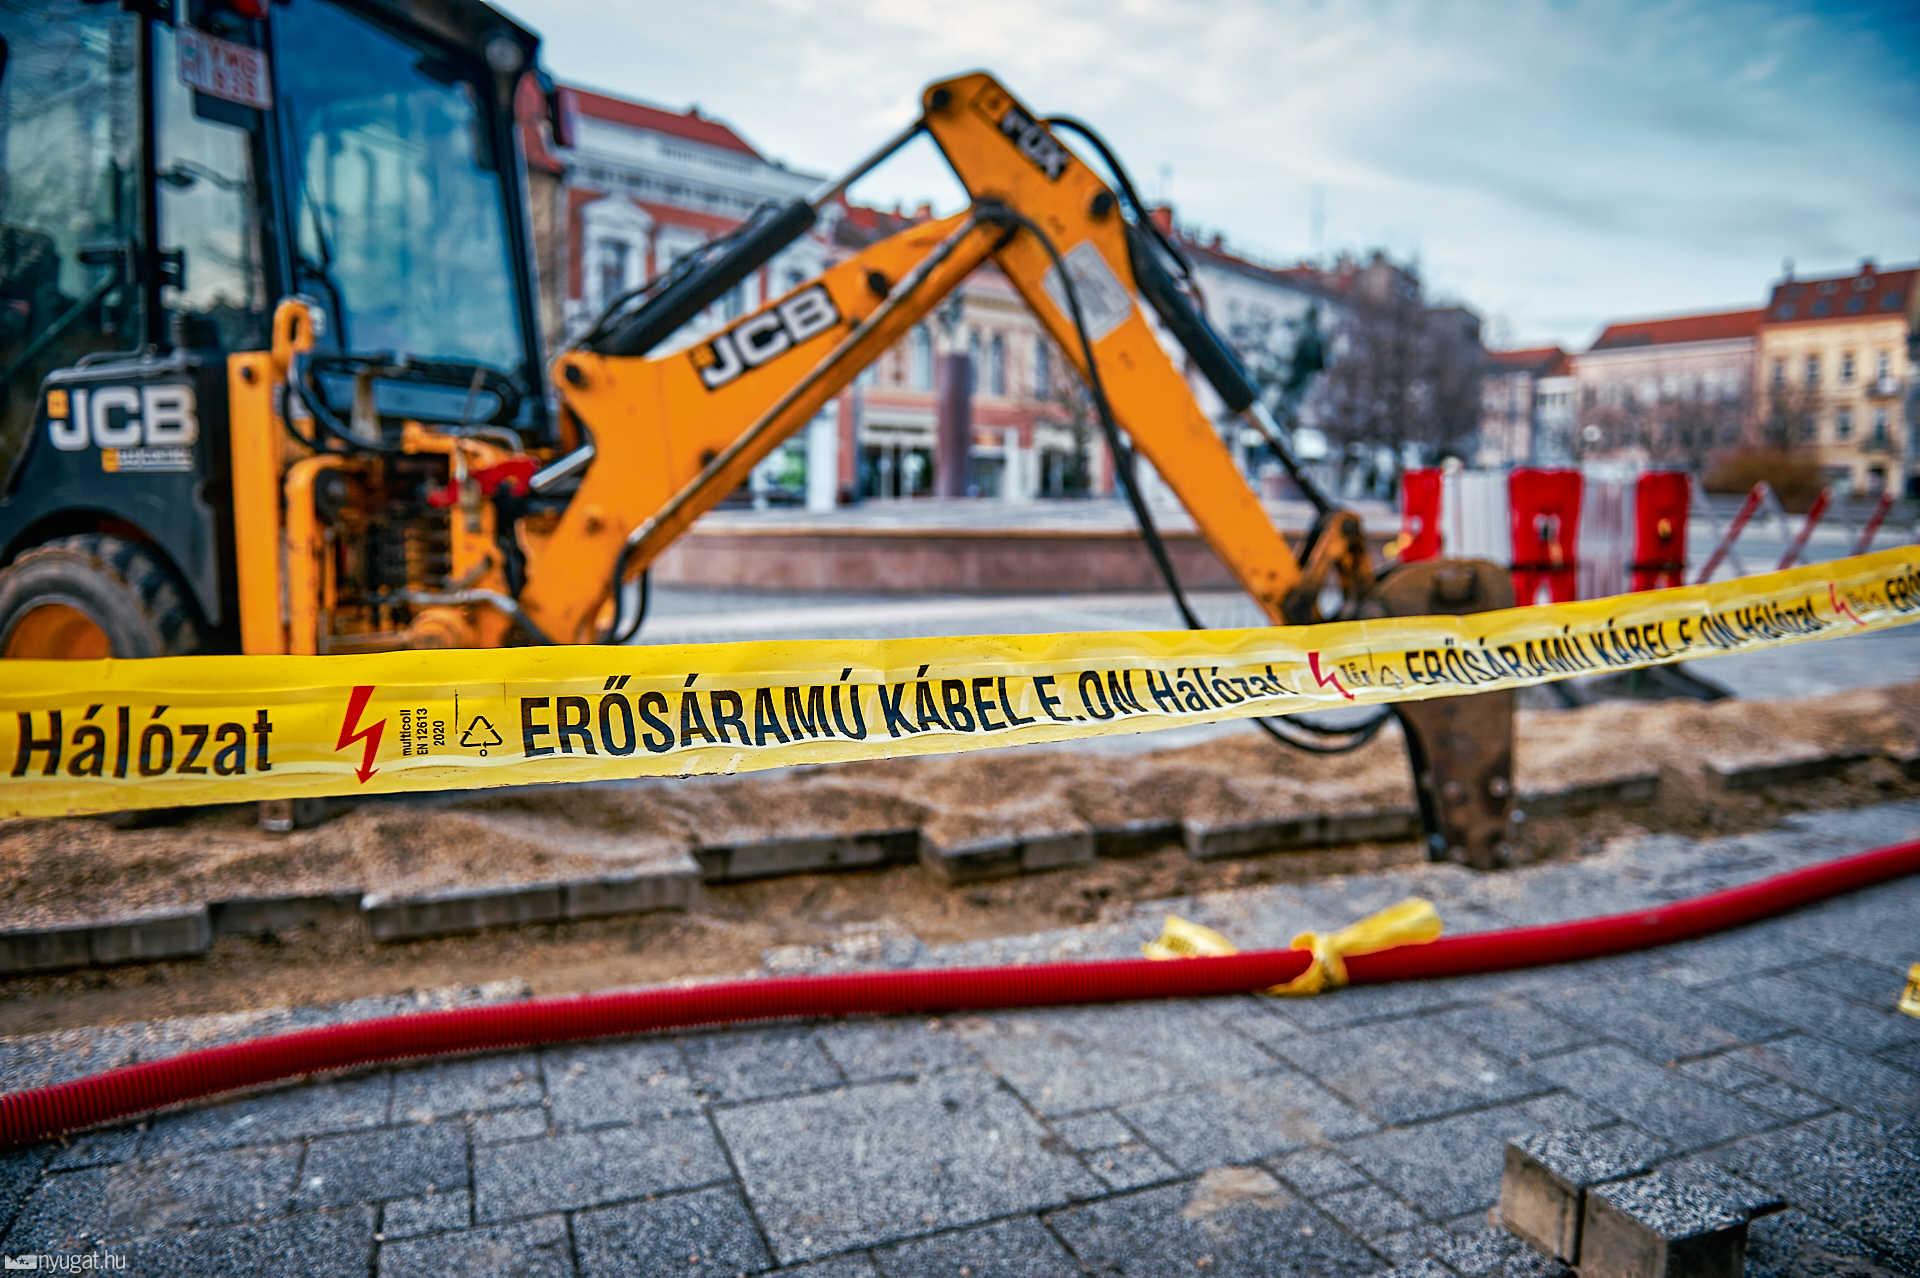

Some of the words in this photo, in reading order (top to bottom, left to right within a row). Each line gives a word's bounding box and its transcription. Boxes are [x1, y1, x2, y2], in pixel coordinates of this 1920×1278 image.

[702, 287, 838, 384] JCB
[48, 385, 199, 451] JCB
[400, 709, 412, 756] multicoll
[416, 708, 428, 741] 12613
[433, 720, 445, 746] 2020
[520, 668, 868, 758] ERŐSÁRAMÚ
[877, 664, 1036, 738] KÁBEL
[1032, 670, 1149, 721] E.ON
[1145, 664, 1300, 713] Hálózat
[10, 703, 273, 779] Hálózat
[416, 744, 429, 755] EN
